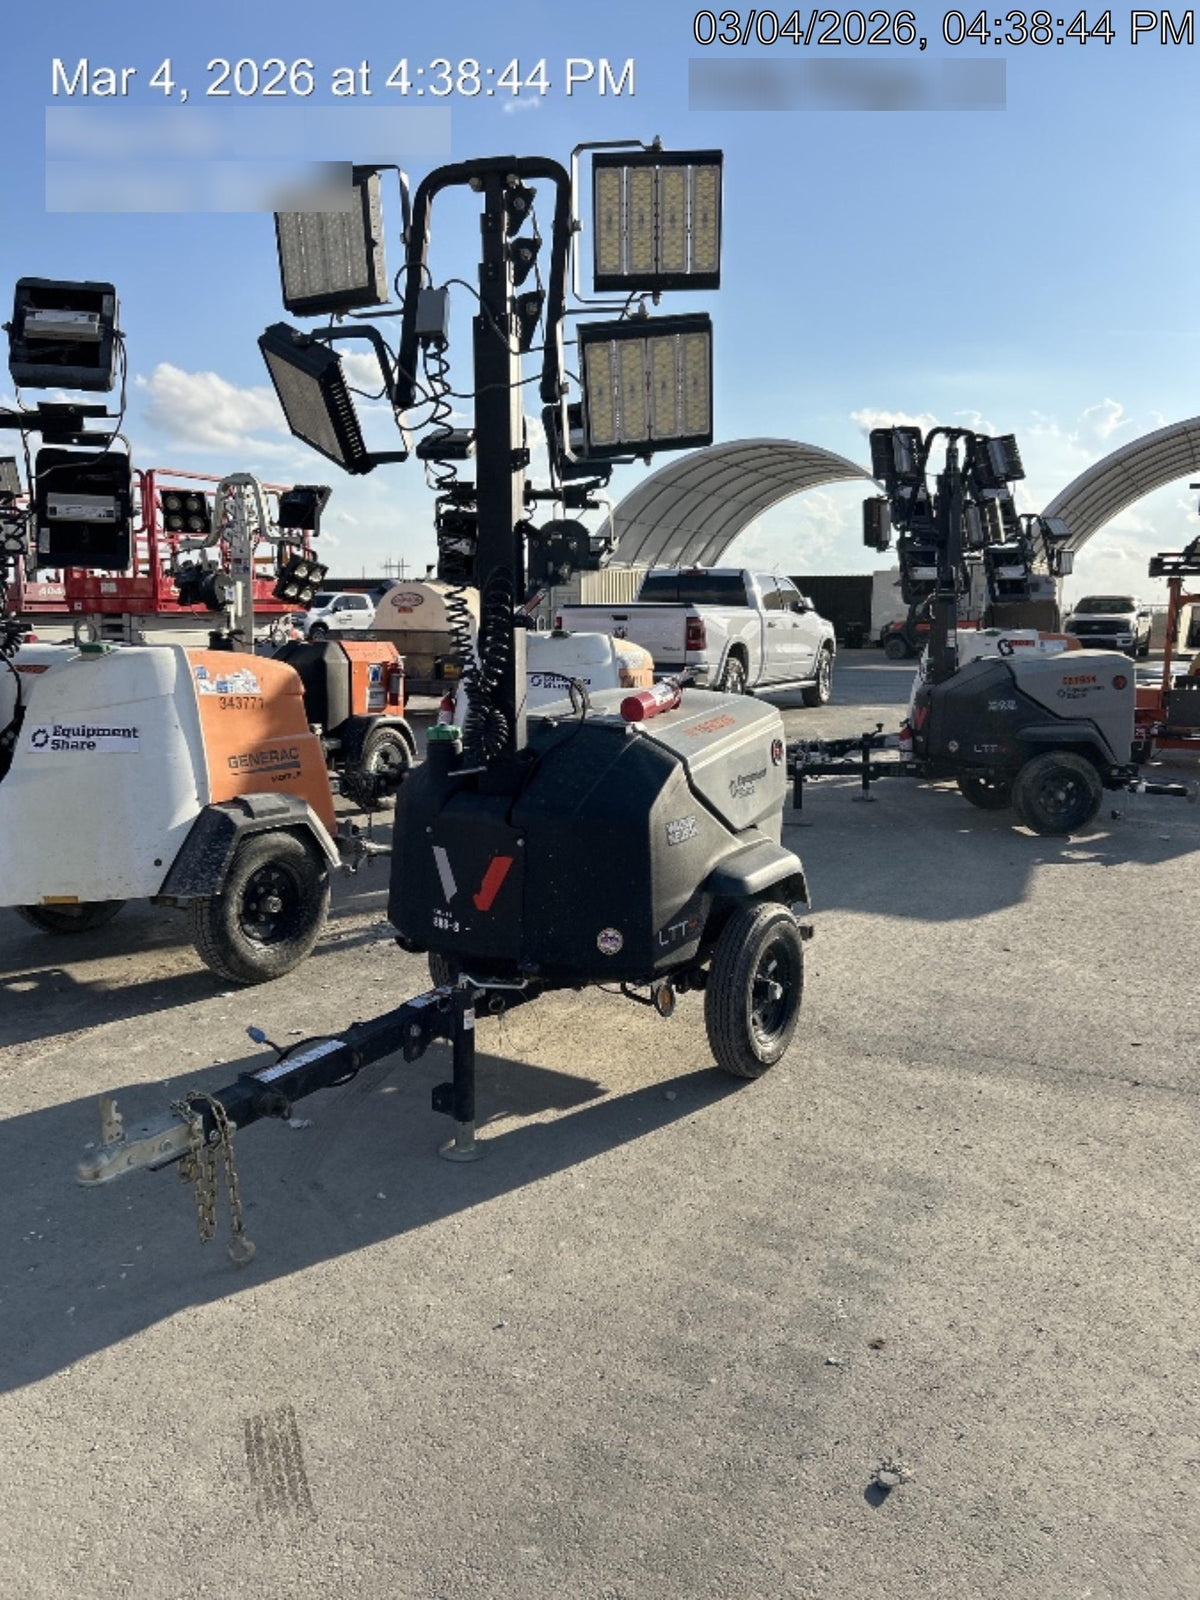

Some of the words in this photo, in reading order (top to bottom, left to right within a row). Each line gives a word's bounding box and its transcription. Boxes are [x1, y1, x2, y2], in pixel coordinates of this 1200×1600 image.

[52, 725, 139, 738] Equipment
[50, 739, 96, 751] Share
[227, 747, 300, 769] GENERAC
